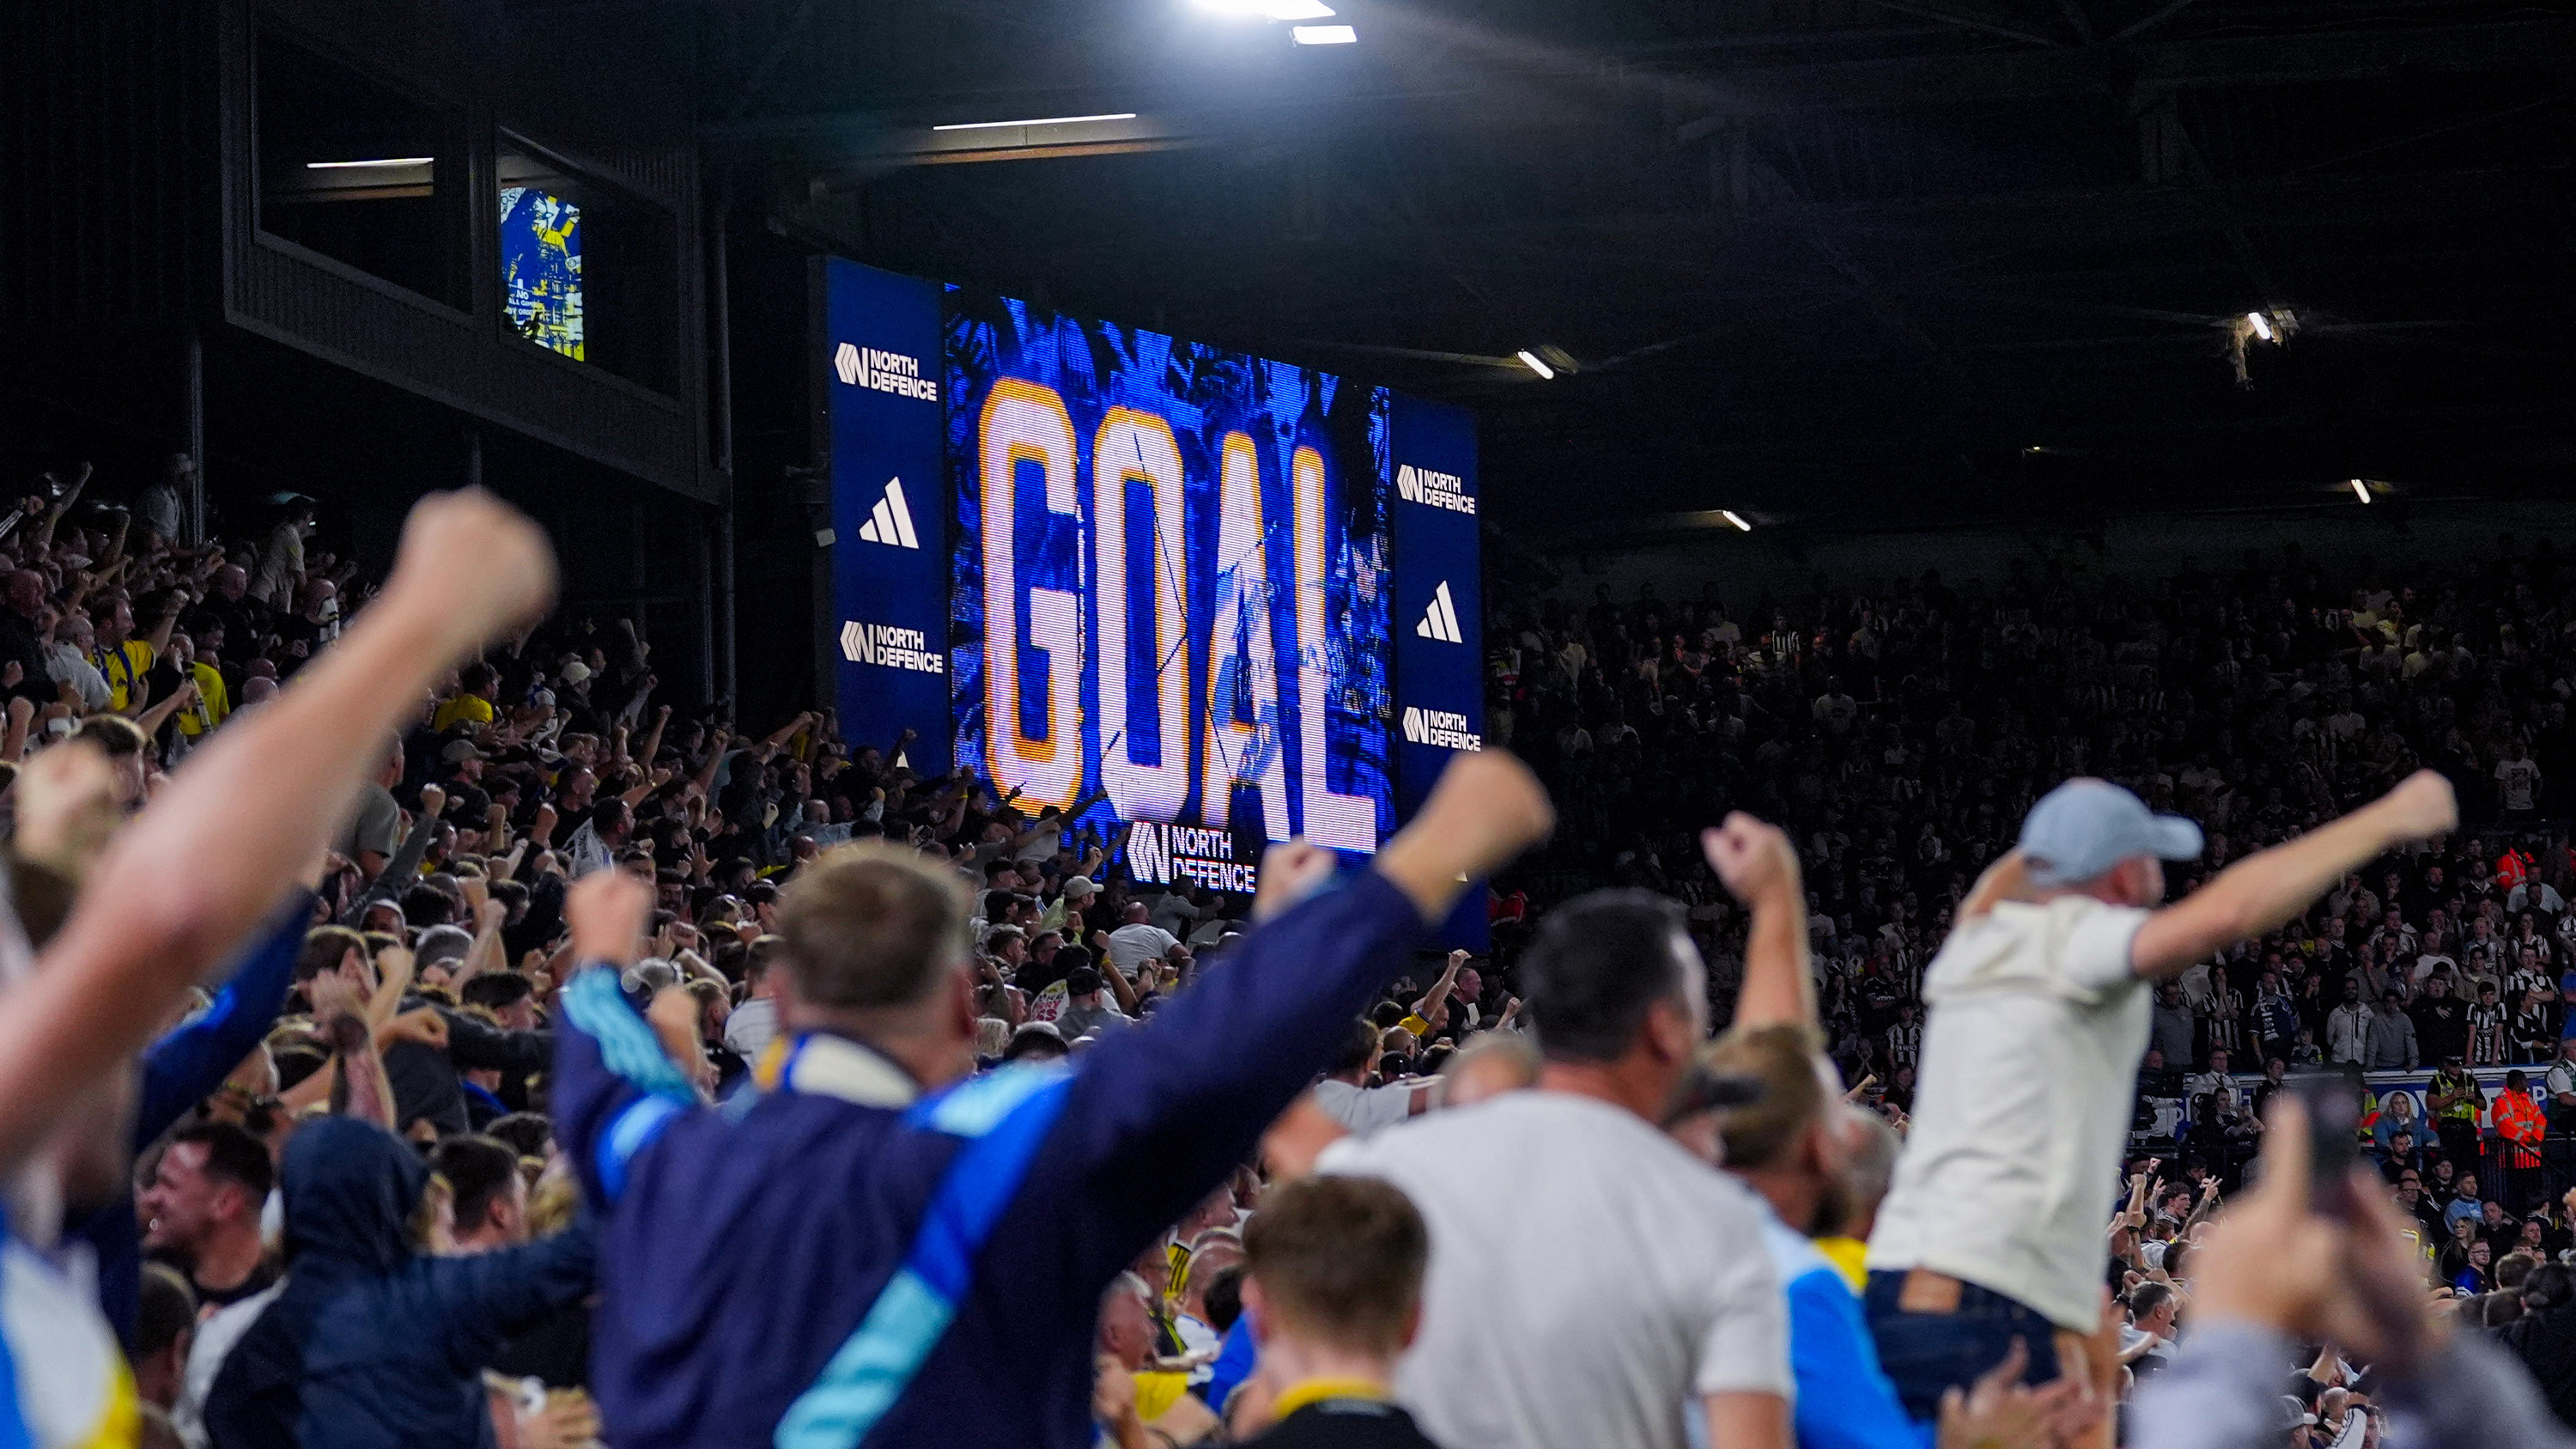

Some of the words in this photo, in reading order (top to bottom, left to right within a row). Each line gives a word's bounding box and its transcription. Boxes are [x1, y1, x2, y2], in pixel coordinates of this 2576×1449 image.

[870, 348, 919, 378] NORTH
[870, 369, 938, 402] DEFENCE
[1424, 469, 1461, 494] NORTH
[1424, 487, 1476, 515] DEFENCE
[979, 375, 1376, 854] GOAL
[876, 624, 925, 651] NORTH
[876, 645, 944, 674] DEFENCE
[1429, 709, 1467, 733] NORTH
[1430, 728, 1481, 752] DEFENCE
[1171, 825, 1232, 860] NORTH
[1172, 857, 1256, 893] DEFENCE
